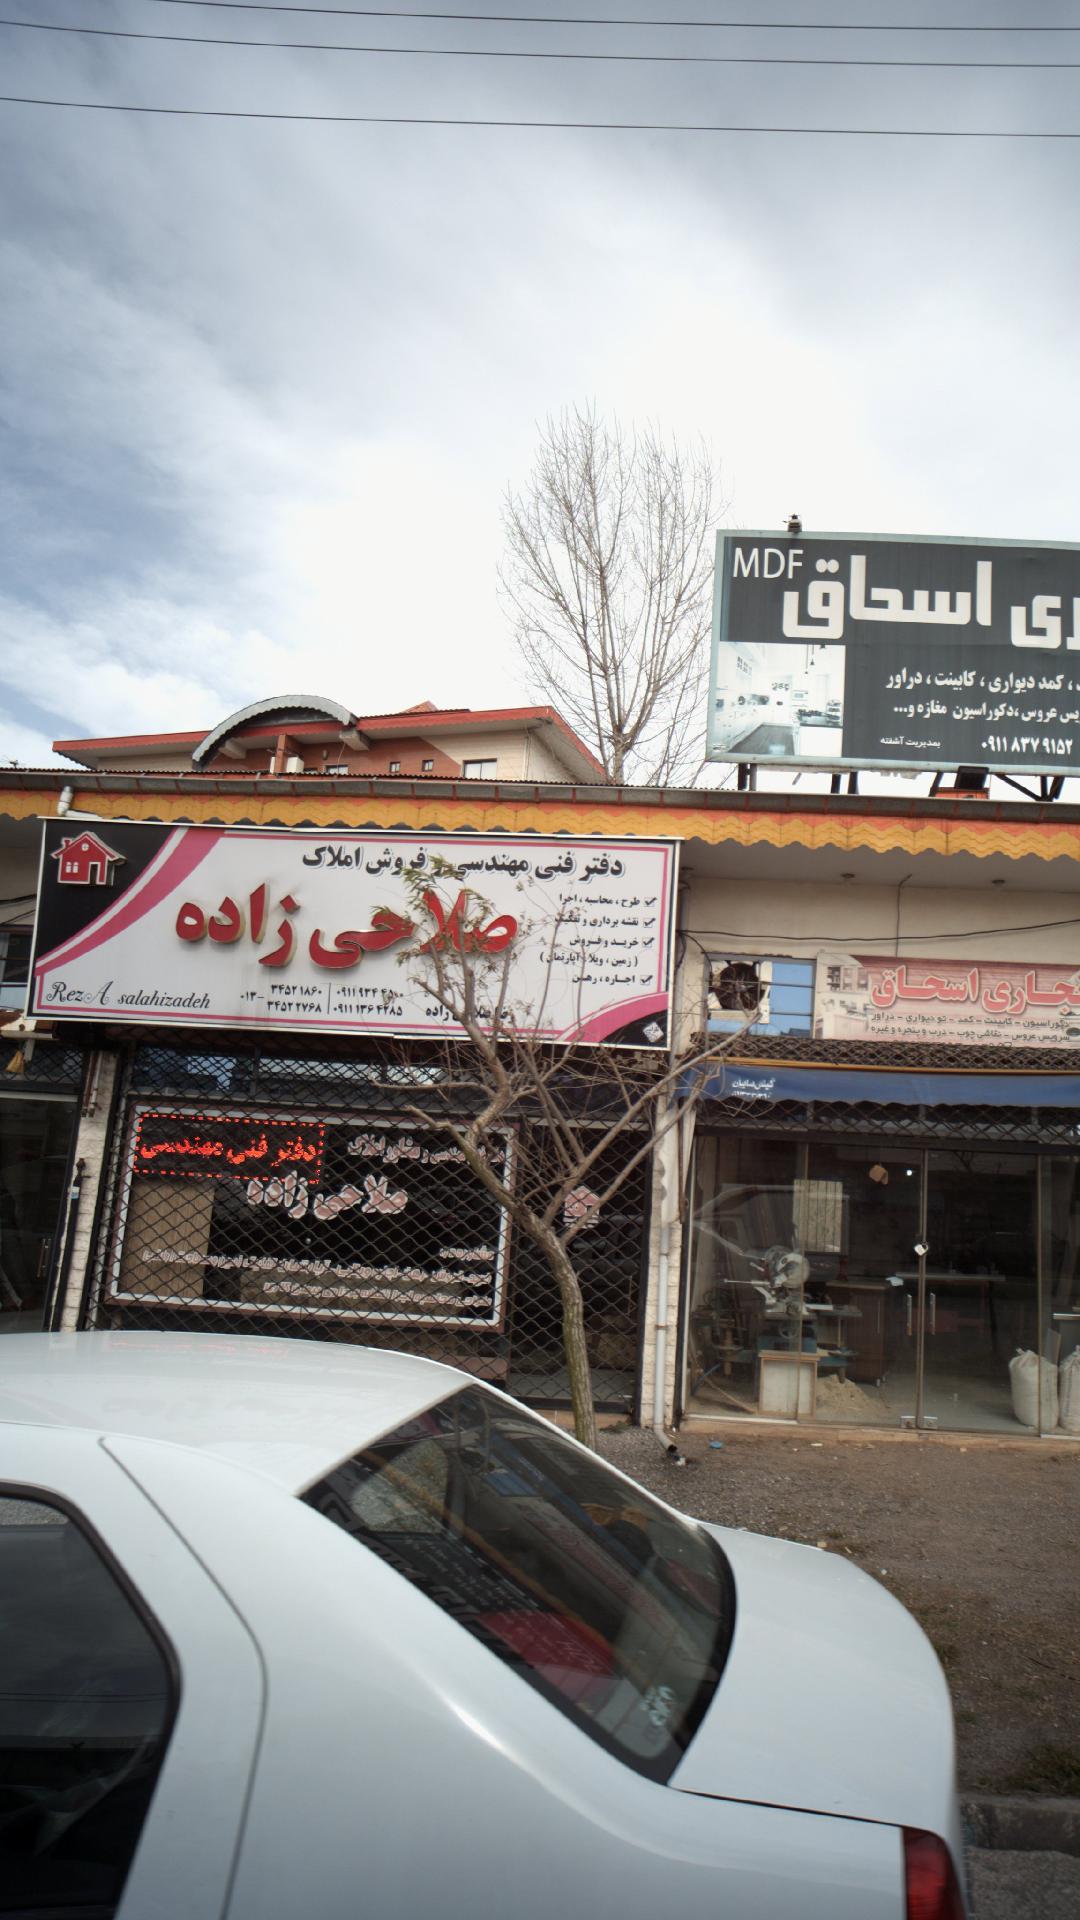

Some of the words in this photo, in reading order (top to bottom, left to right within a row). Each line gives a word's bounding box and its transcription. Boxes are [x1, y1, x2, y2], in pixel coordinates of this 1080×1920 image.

[733, 547, 804, 579] MDF
[782, 555, 993, 639] اسحاق
[885, 667, 922, 690] دراور
[935, 670, 976, 691] کابینت
[988, 672, 1035, 693] دیواری
[1038, 674, 1064, 691] کمد
[917, 699, 948, 719] مغازه
[1021, 706, 1058, 722] عروس
[303, 845, 361, 868] املاک
[366, 847, 426, 876] فروش
[456, 854, 530, 878] مهندسی
[535, 851, 574, 879] فنی
[579, 853, 623, 882] دفتر
[621, 896, 640, 908] طرح
[176, 882, 299, 967] زاده
[309, 887, 518, 969] صلاحی
[589, 915, 619, 928] برداری
[610, 938, 639, 949] خرید
[870, 965, 980, 1008] اسحاق
[117, 989, 211, 1009] salahizadeh
[140, 1136, 224, 1159] مهندسی
[226, 1133, 269, 1165] فنی
[270, 1136, 317, 1167] دفتر
[247, 1170, 309, 1219] زاده
[314, 1173, 409, 1220] صلاحی
